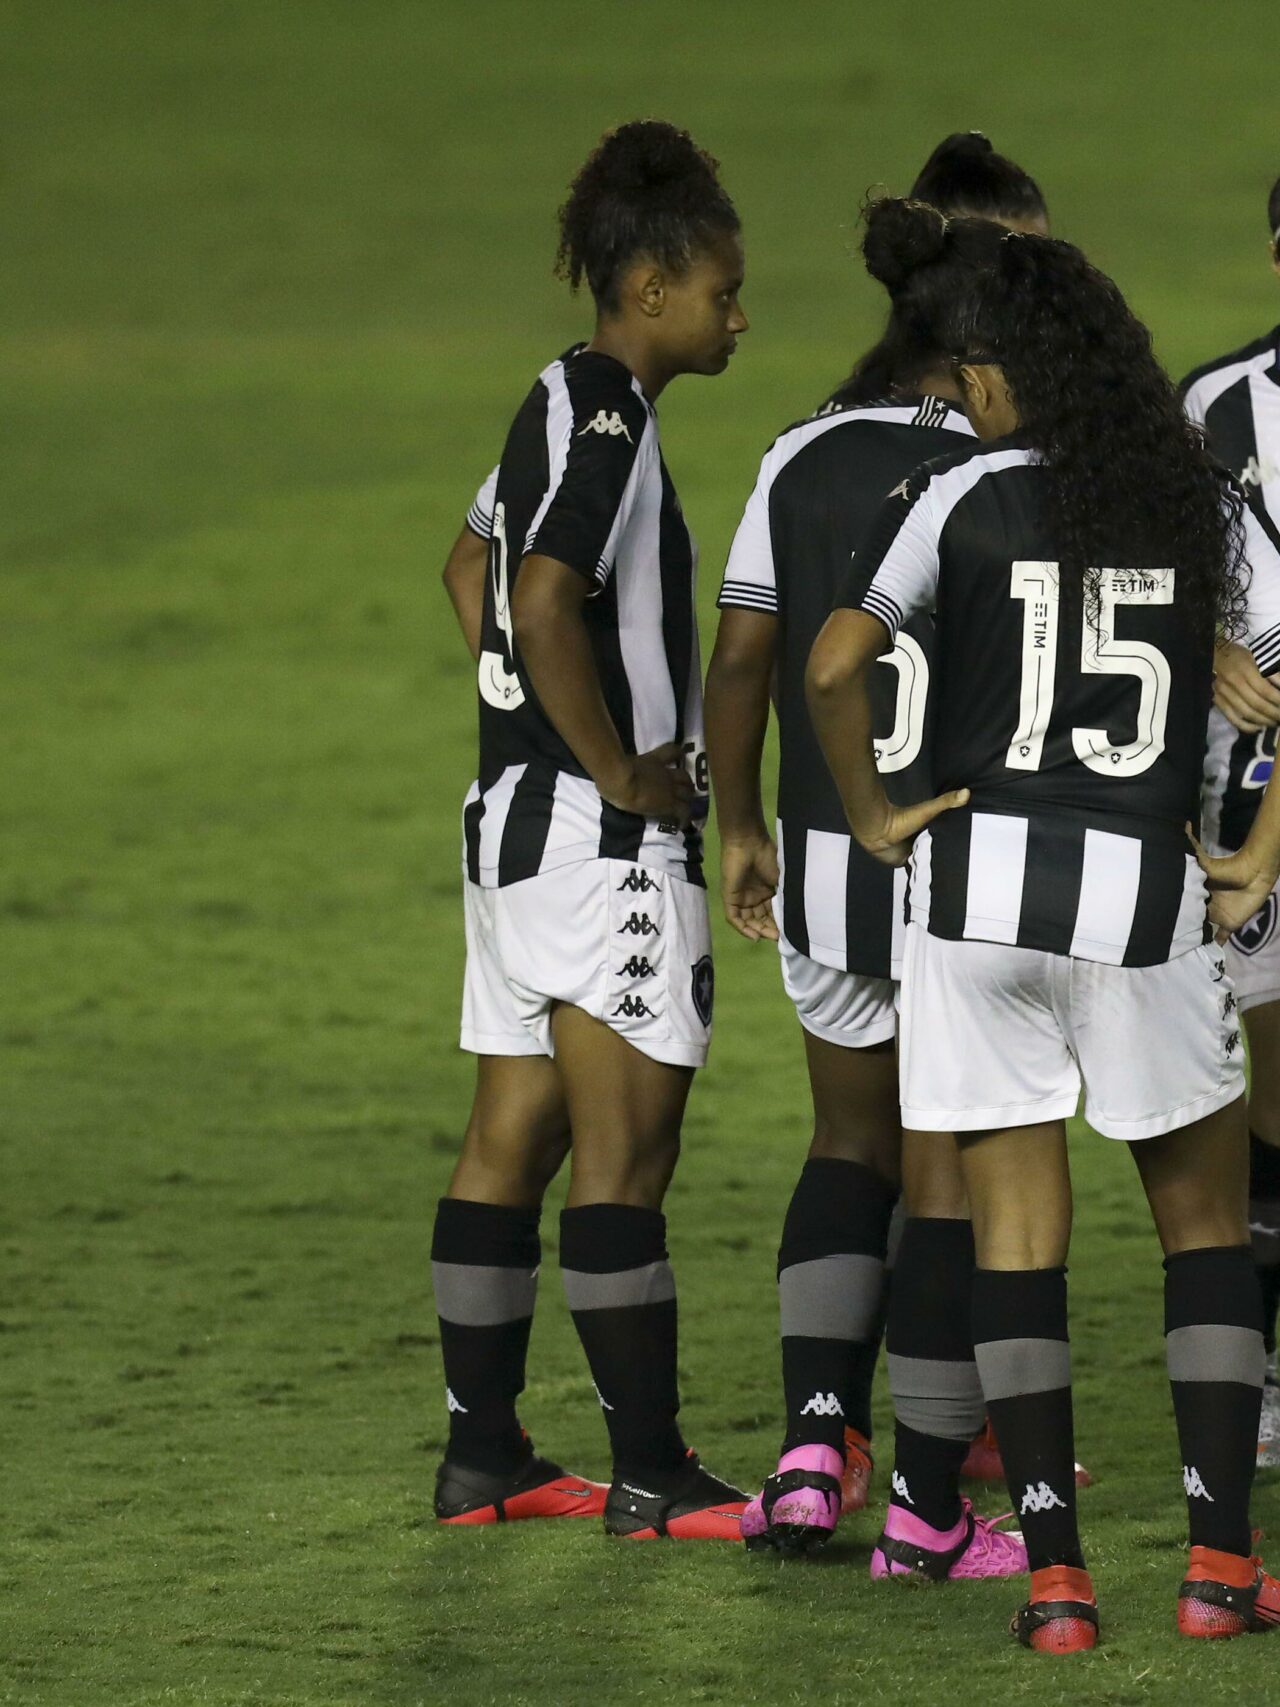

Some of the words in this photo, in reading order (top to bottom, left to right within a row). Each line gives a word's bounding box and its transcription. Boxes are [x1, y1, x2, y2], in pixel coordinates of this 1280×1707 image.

[1130, 579, 1155, 593] TIM
[1033, 620, 1047, 649] TIM
[1005, 561, 1175, 778] 15
